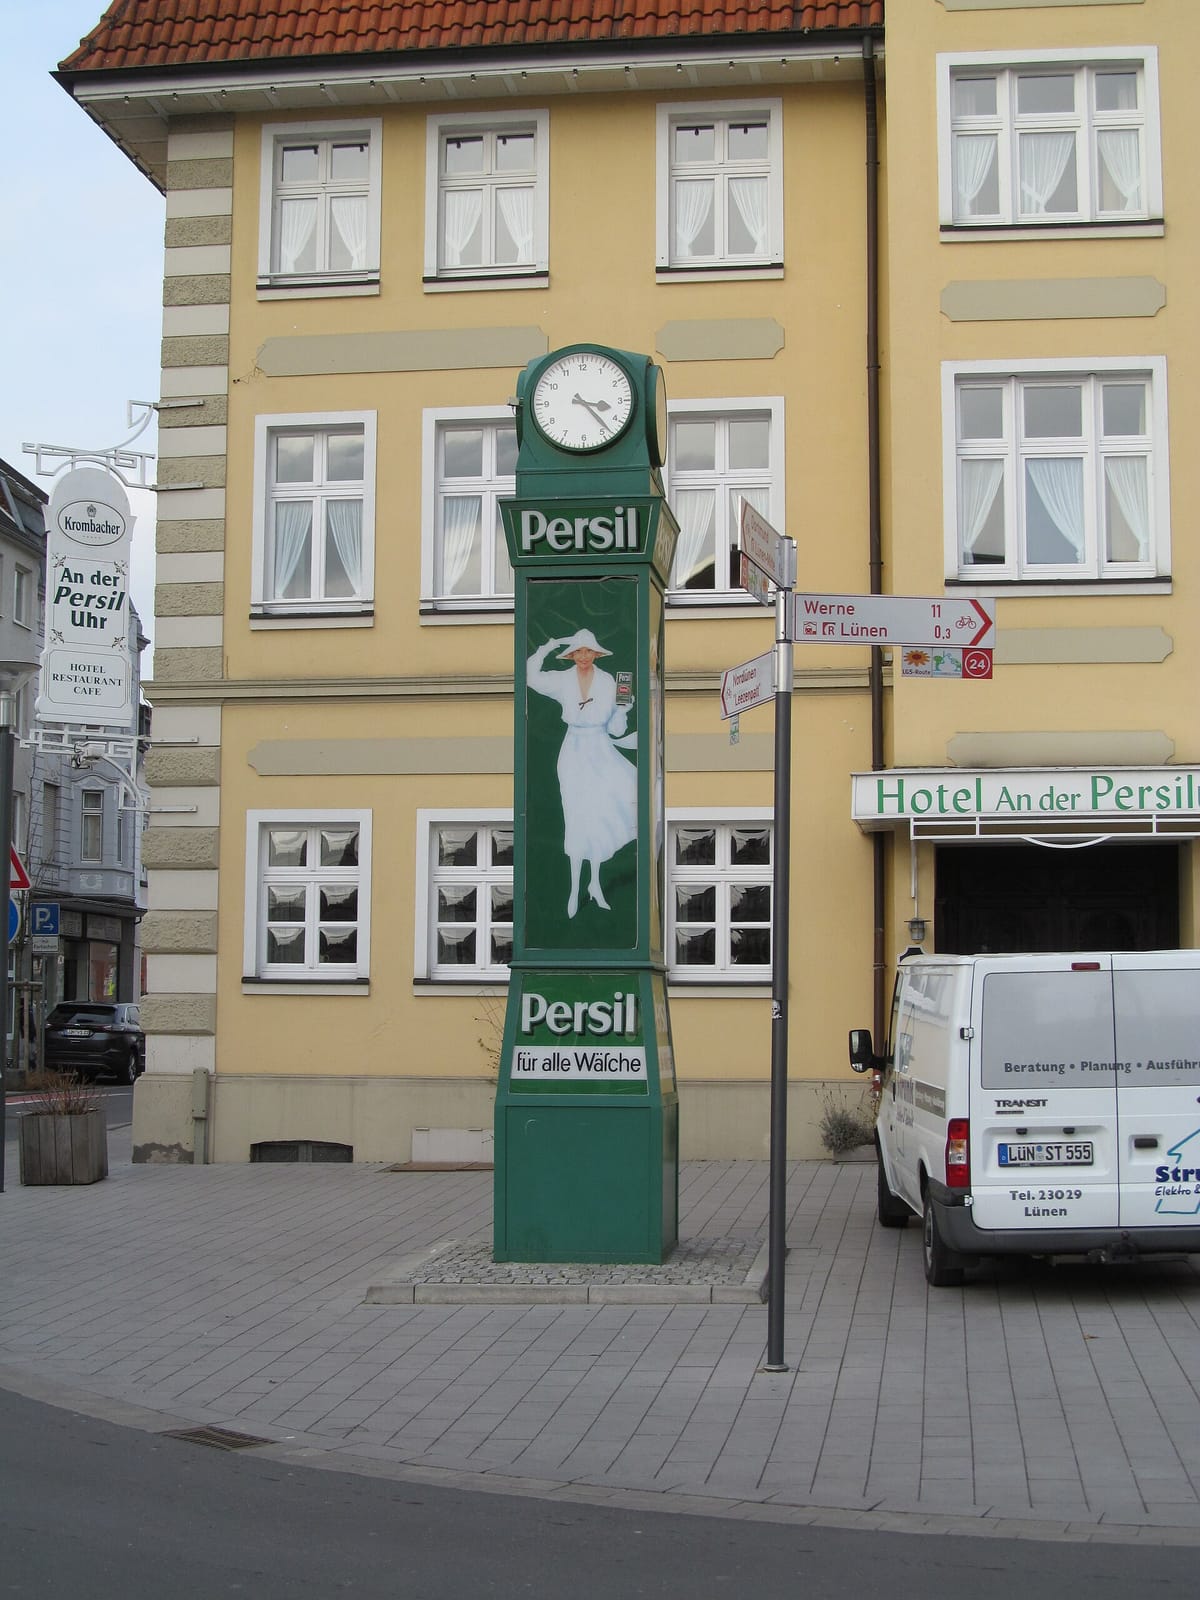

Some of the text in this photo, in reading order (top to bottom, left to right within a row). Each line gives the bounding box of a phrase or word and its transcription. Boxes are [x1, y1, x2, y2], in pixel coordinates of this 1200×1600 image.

[549, 383, 558, 391] 10
[612, 380, 618, 388] 2
[580, 434, 587, 442] 6
[599, 428, 606, 436] 5
[65, 516, 120, 535] Krombacher
[521, 506, 637, 550] Persil
[60, 567, 120, 587] An der
[53, 586, 126, 611] Persil
[804, 600, 941, 618] Werne 11
[70, 610, 107, 629] Uhr
[841, 622, 888, 638] Lünen
[70, 663, 106, 674] HOTEL
[969, 658, 986, 671] 24
[52, 673, 124, 687] RESTAURANT
[73, 686, 102, 696] CAFE
[877, 774, 1200, 814] Hotel An der Persil
[36, 907, 50, 931] P
[521, 992, 635, 1034] Persil
[517, 1051, 537, 1071] für
[542, 1052, 571, 1071] alle
[1004, 1059, 1200, 1075] Beratung Planung Ausführ
[995, 1099, 1048, 1107] TRANSIT
[1046, 1146, 1062, 1160] ST
[1066, 1145, 1091, 1160] 555
[1009, 1190, 1035, 1200] Tel.
[1155, 1185, 1191, 1196] Elektro
[1024, 1206, 1067, 1216] Lünen
